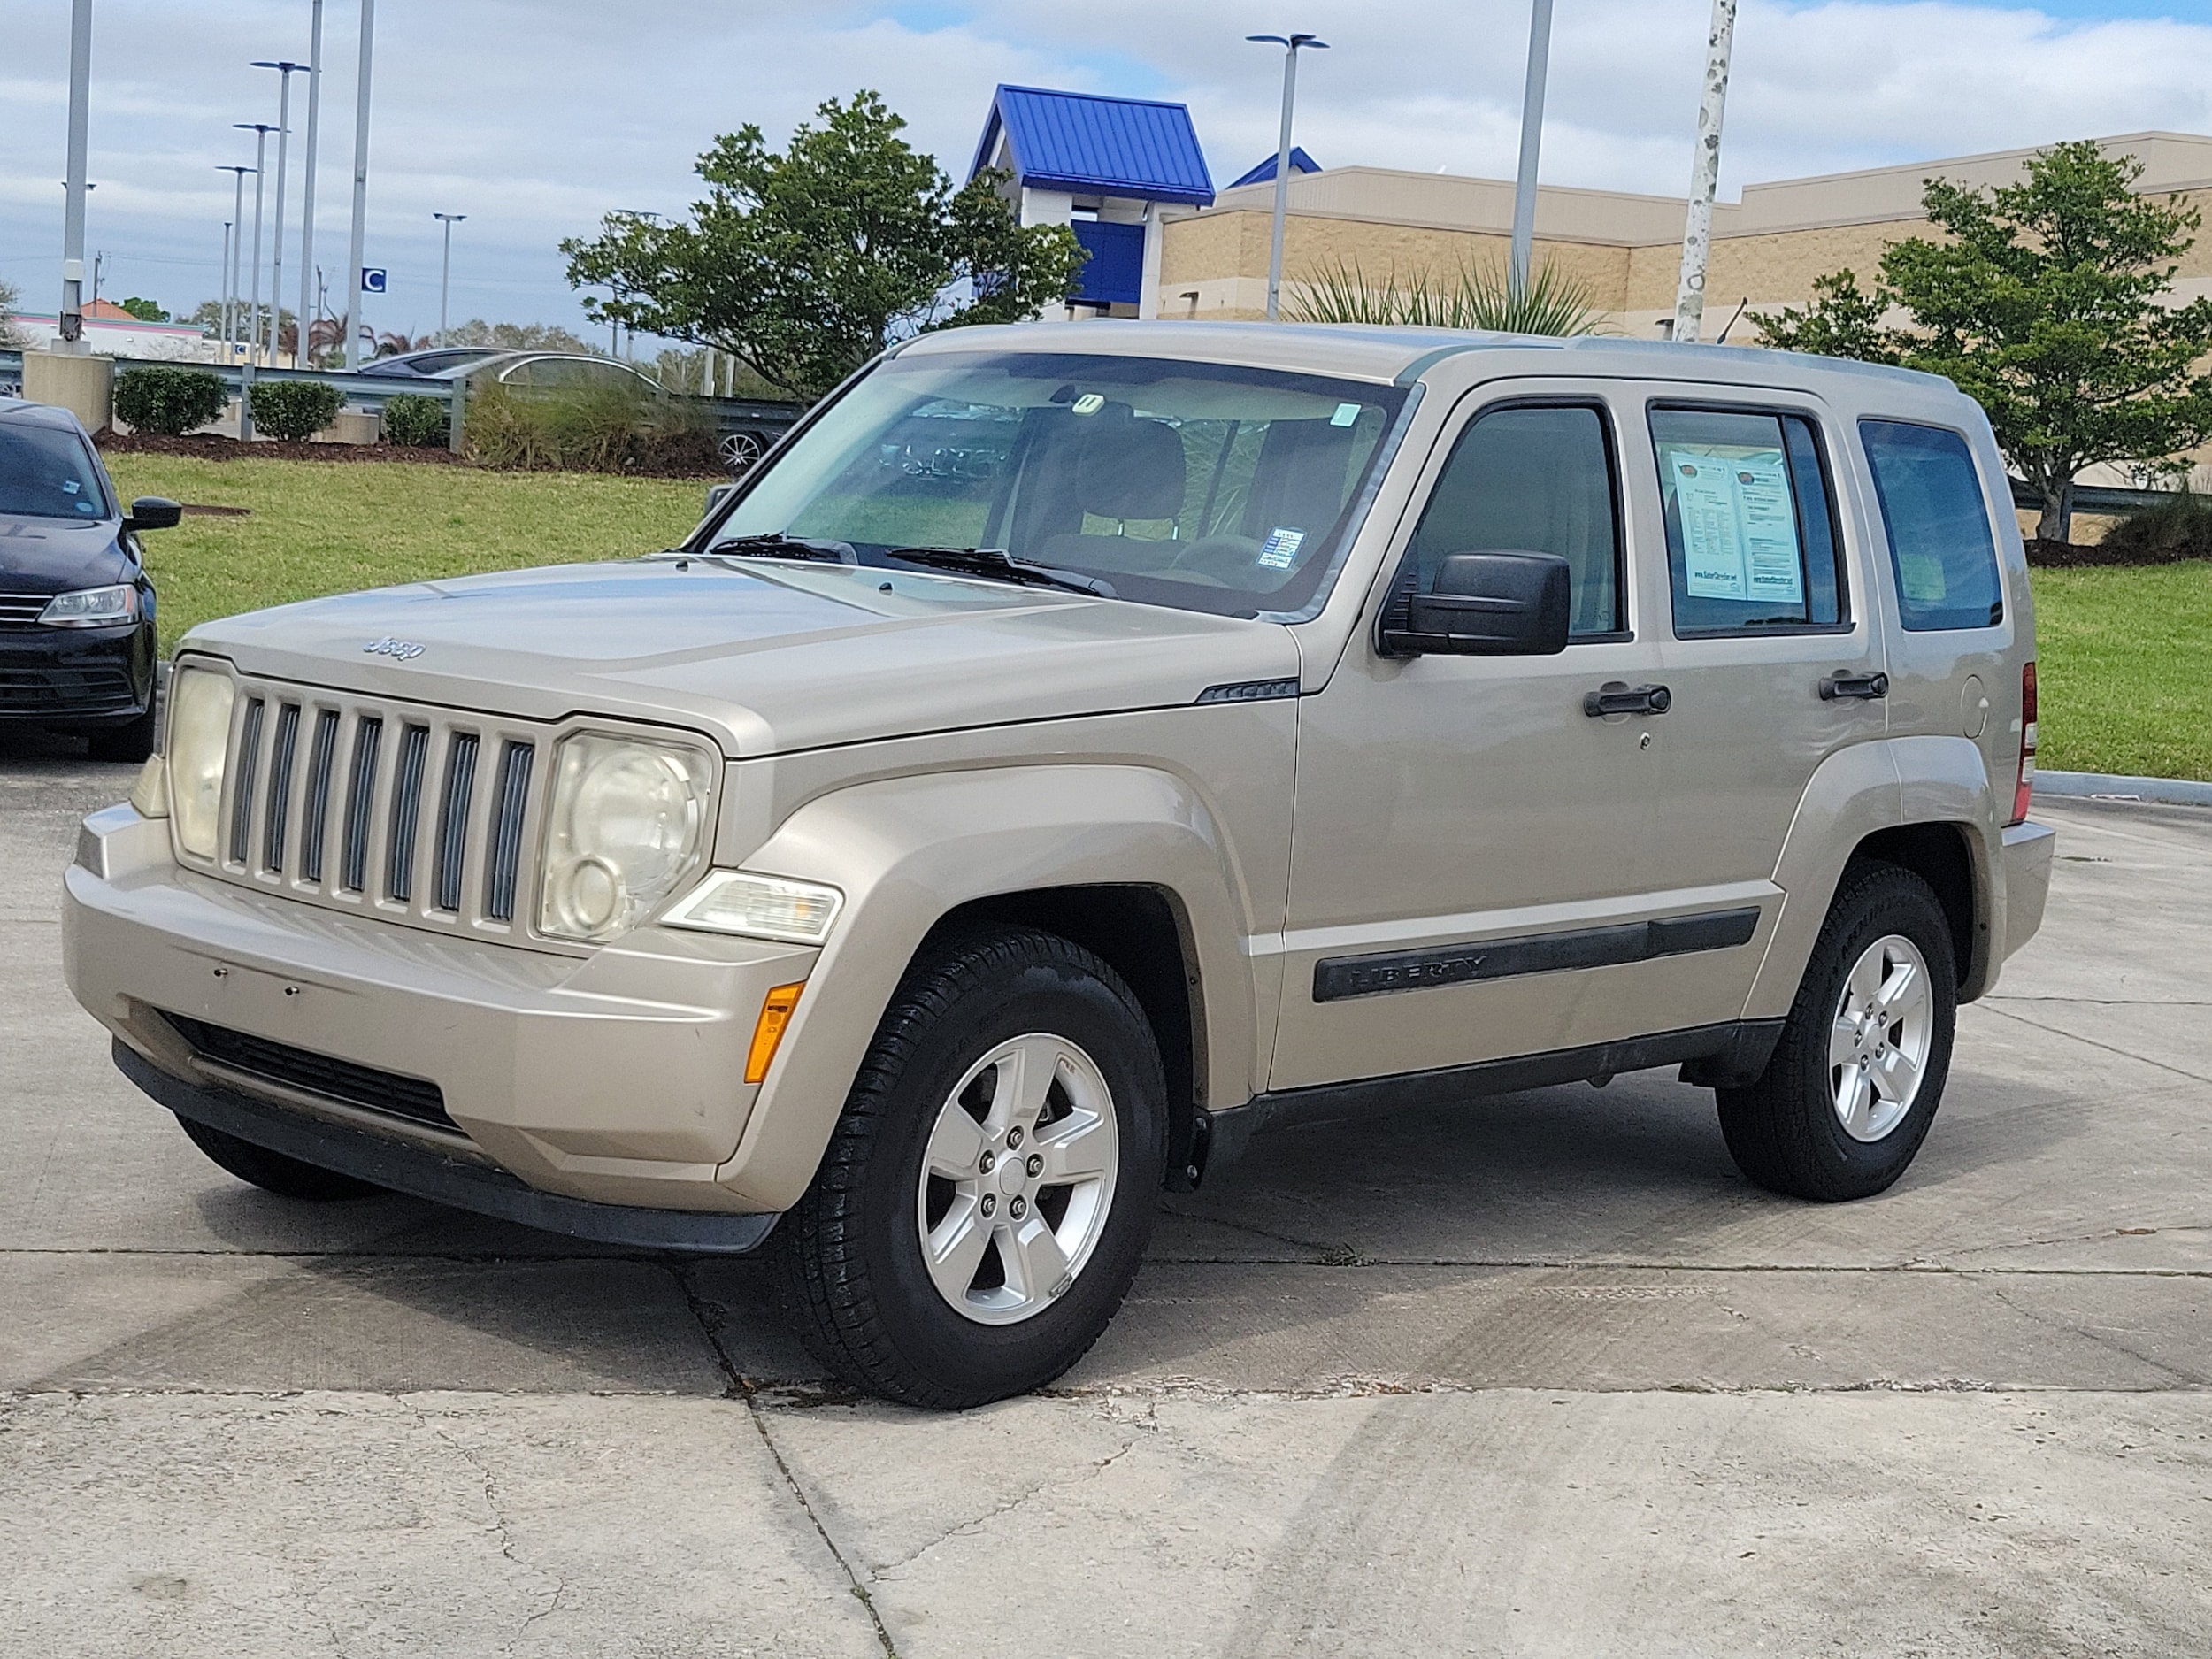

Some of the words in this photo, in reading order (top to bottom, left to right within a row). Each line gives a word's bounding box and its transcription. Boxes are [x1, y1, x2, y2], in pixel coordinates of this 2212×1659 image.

[365, 270, 384, 291] C
[363, 636, 426, 662] Jeep
[1349, 955, 1487, 987] LIBERTY
